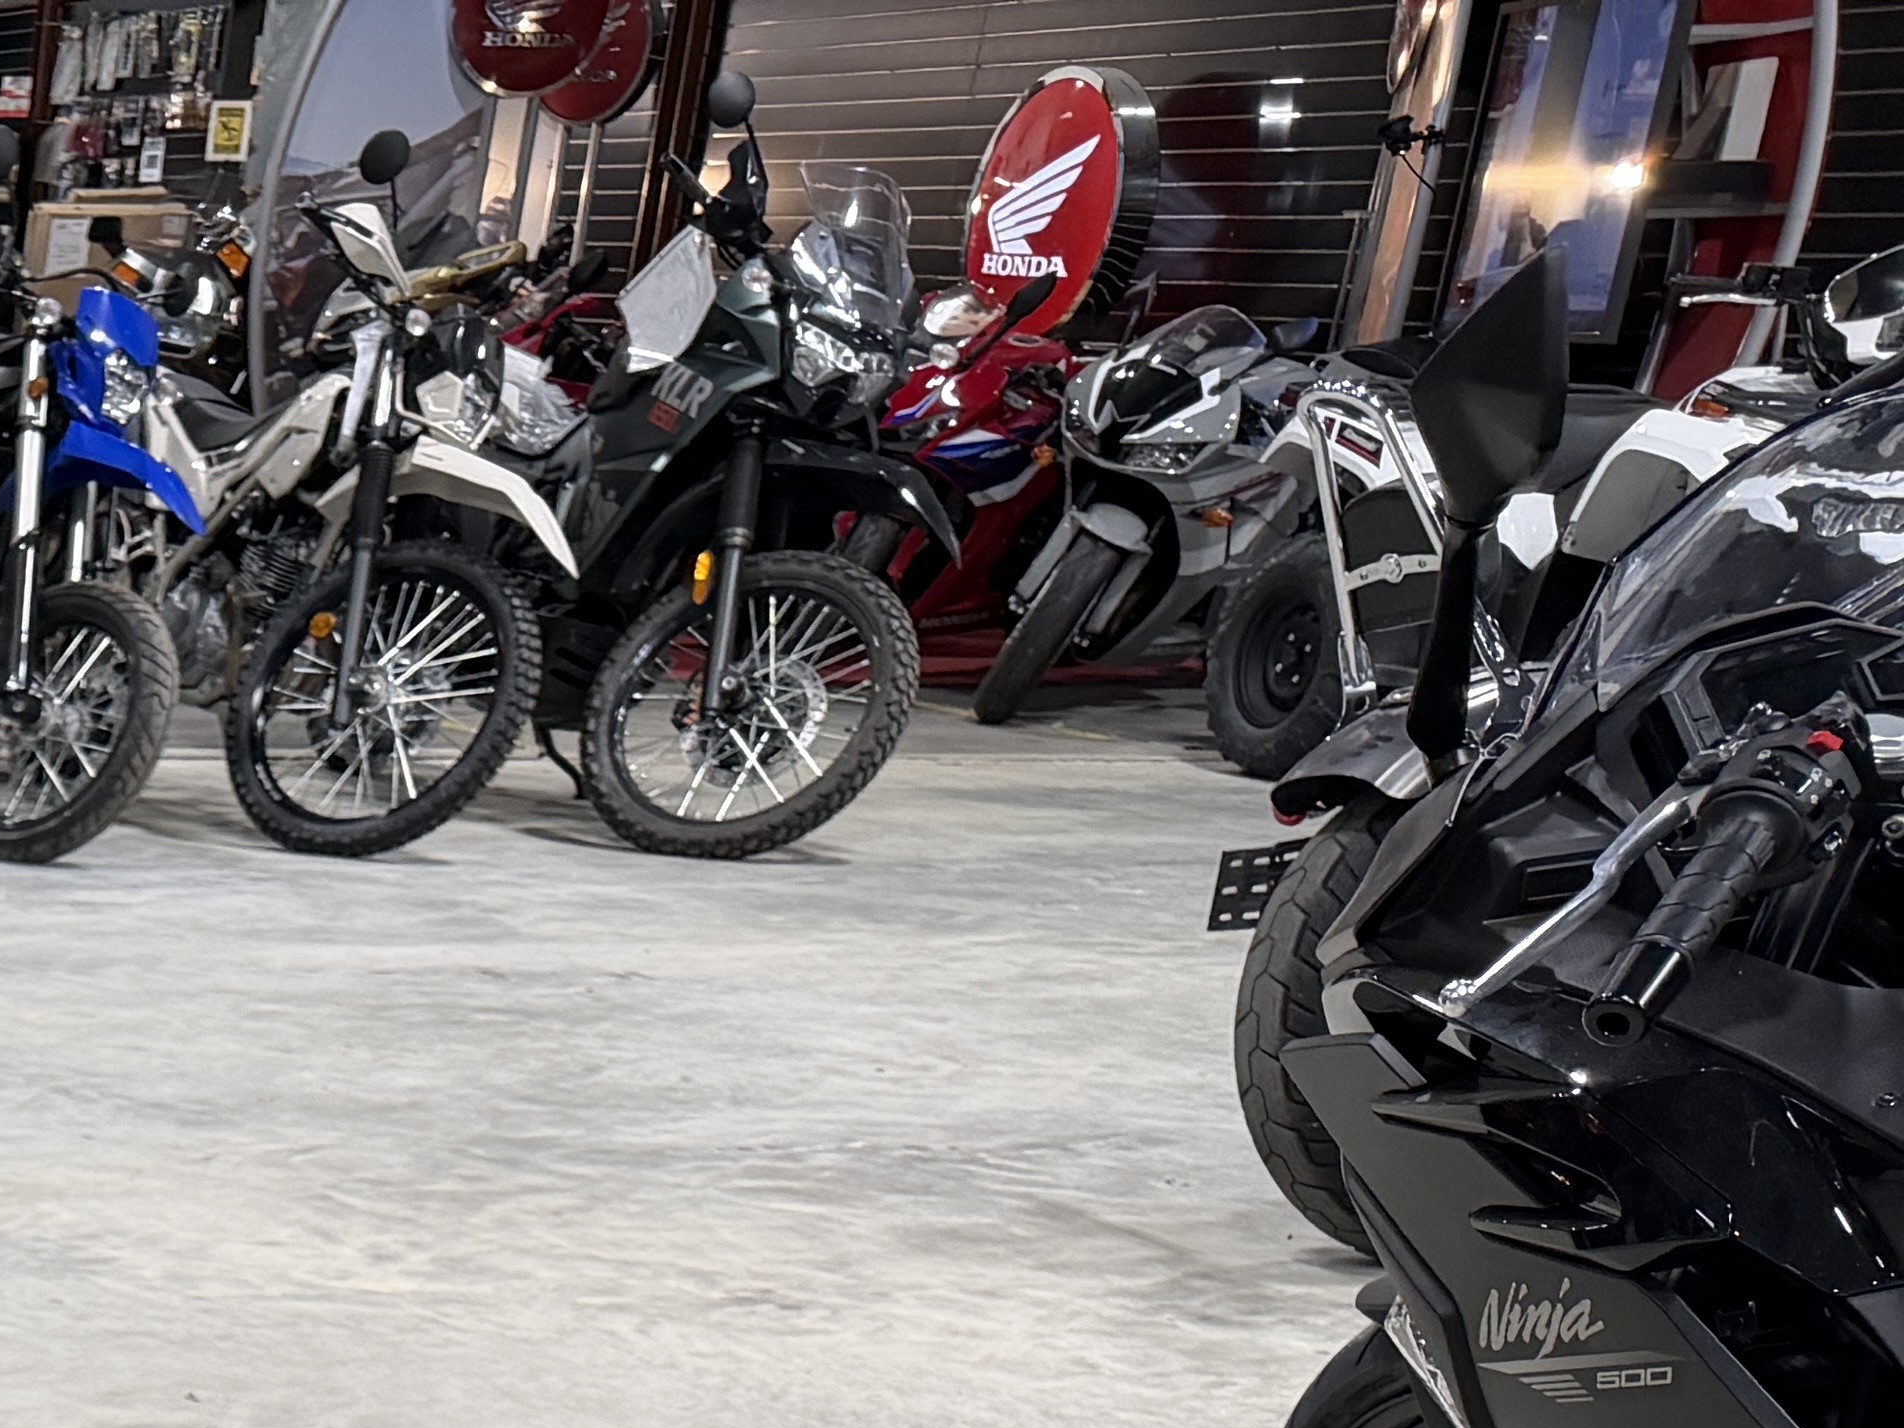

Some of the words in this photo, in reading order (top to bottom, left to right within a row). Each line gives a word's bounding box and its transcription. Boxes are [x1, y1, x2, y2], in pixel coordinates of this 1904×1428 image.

[980, 252, 1069, 278] HONDA
[650, 361, 715, 420] KLR
[1478, 1276, 1605, 1361] Ninja
[1596, 1366, 1673, 1390] 500
